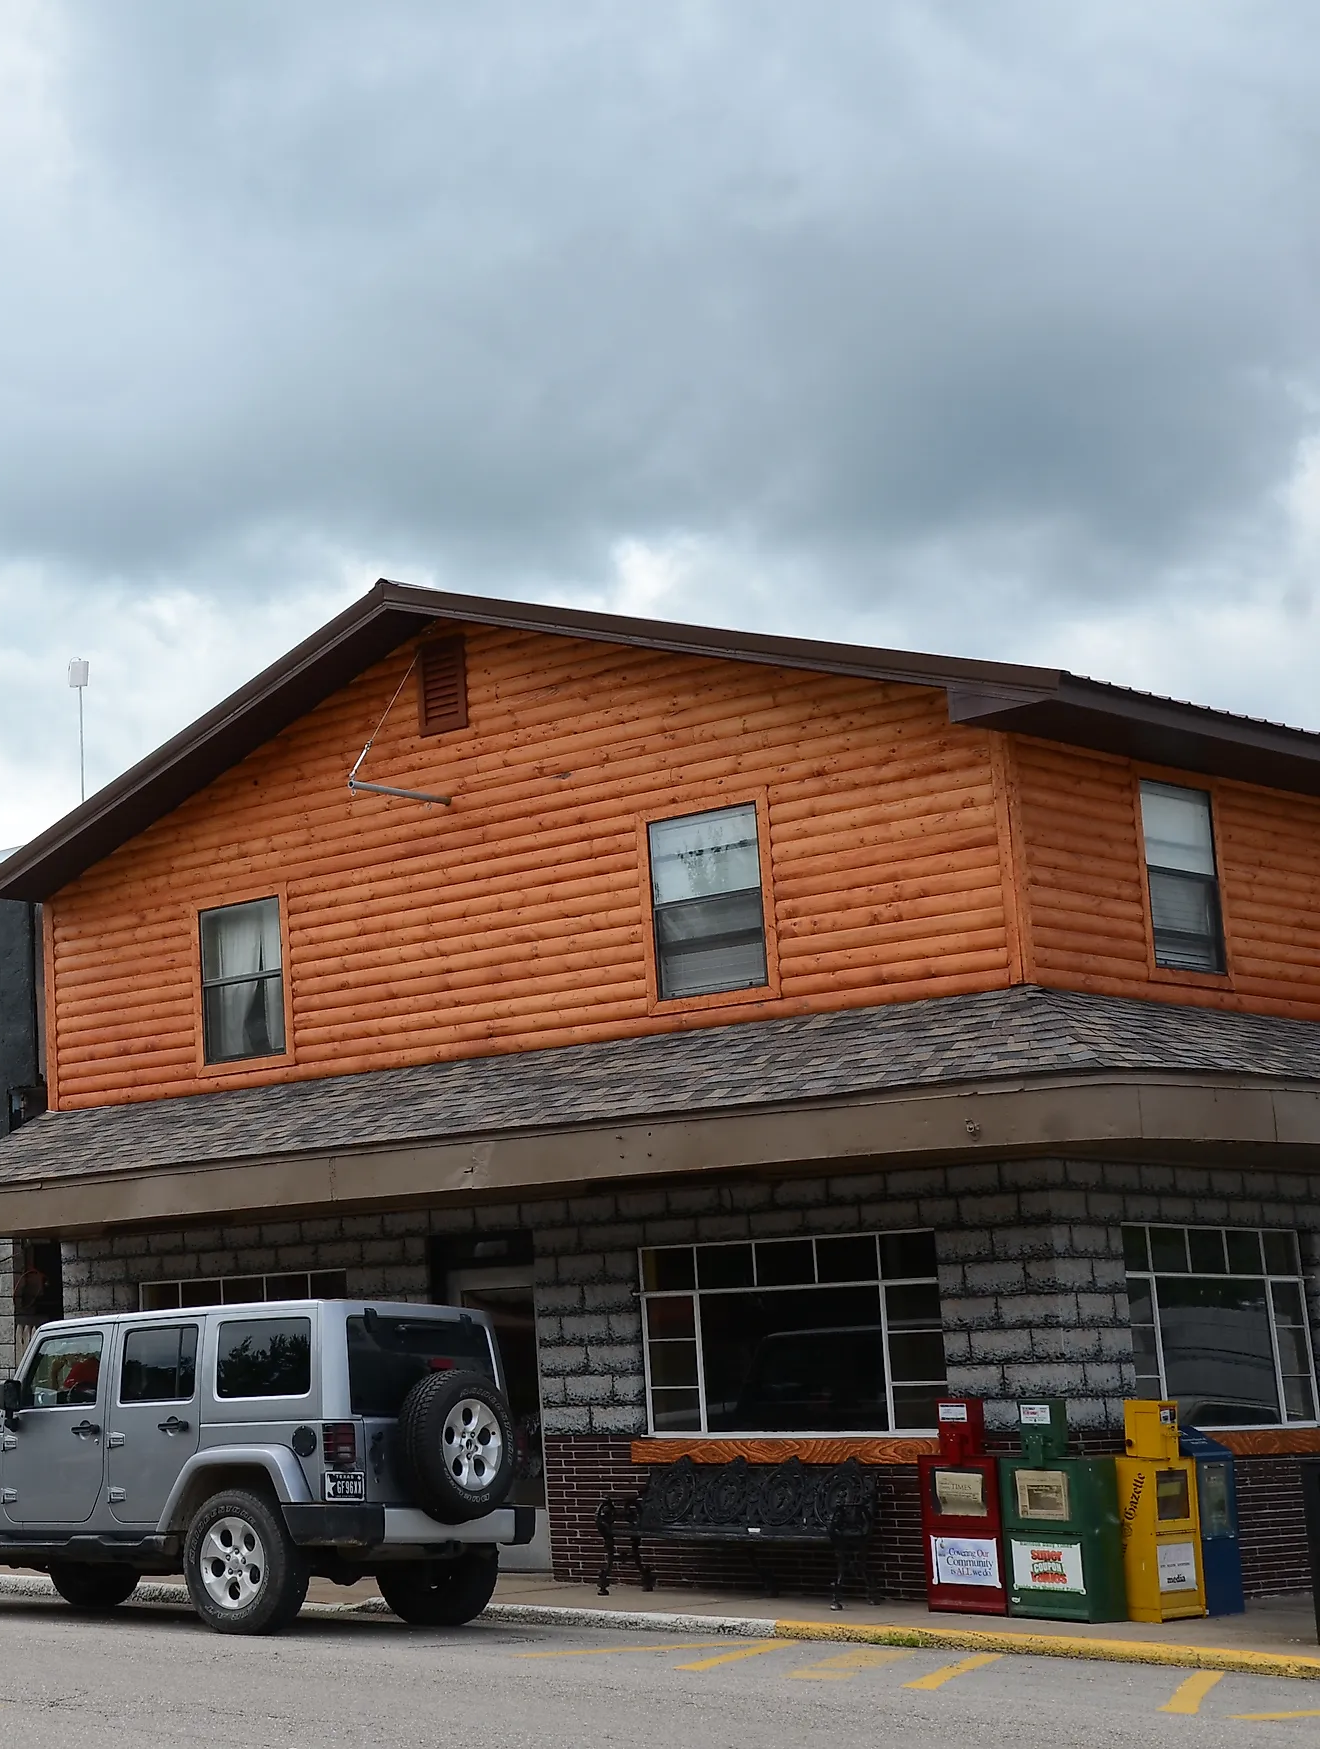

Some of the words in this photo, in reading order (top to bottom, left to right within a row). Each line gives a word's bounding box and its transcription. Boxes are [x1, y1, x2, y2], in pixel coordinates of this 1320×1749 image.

[1124, 1472, 1146, 1521] Gazette
[948, 1548, 976, 1559] Covering
[977, 1549, 989, 1557] Our
[946, 1556, 994, 1567] Community
[1033, 1562, 1063, 1573] COUPON
[1166, 1573, 1187, 1584] media
